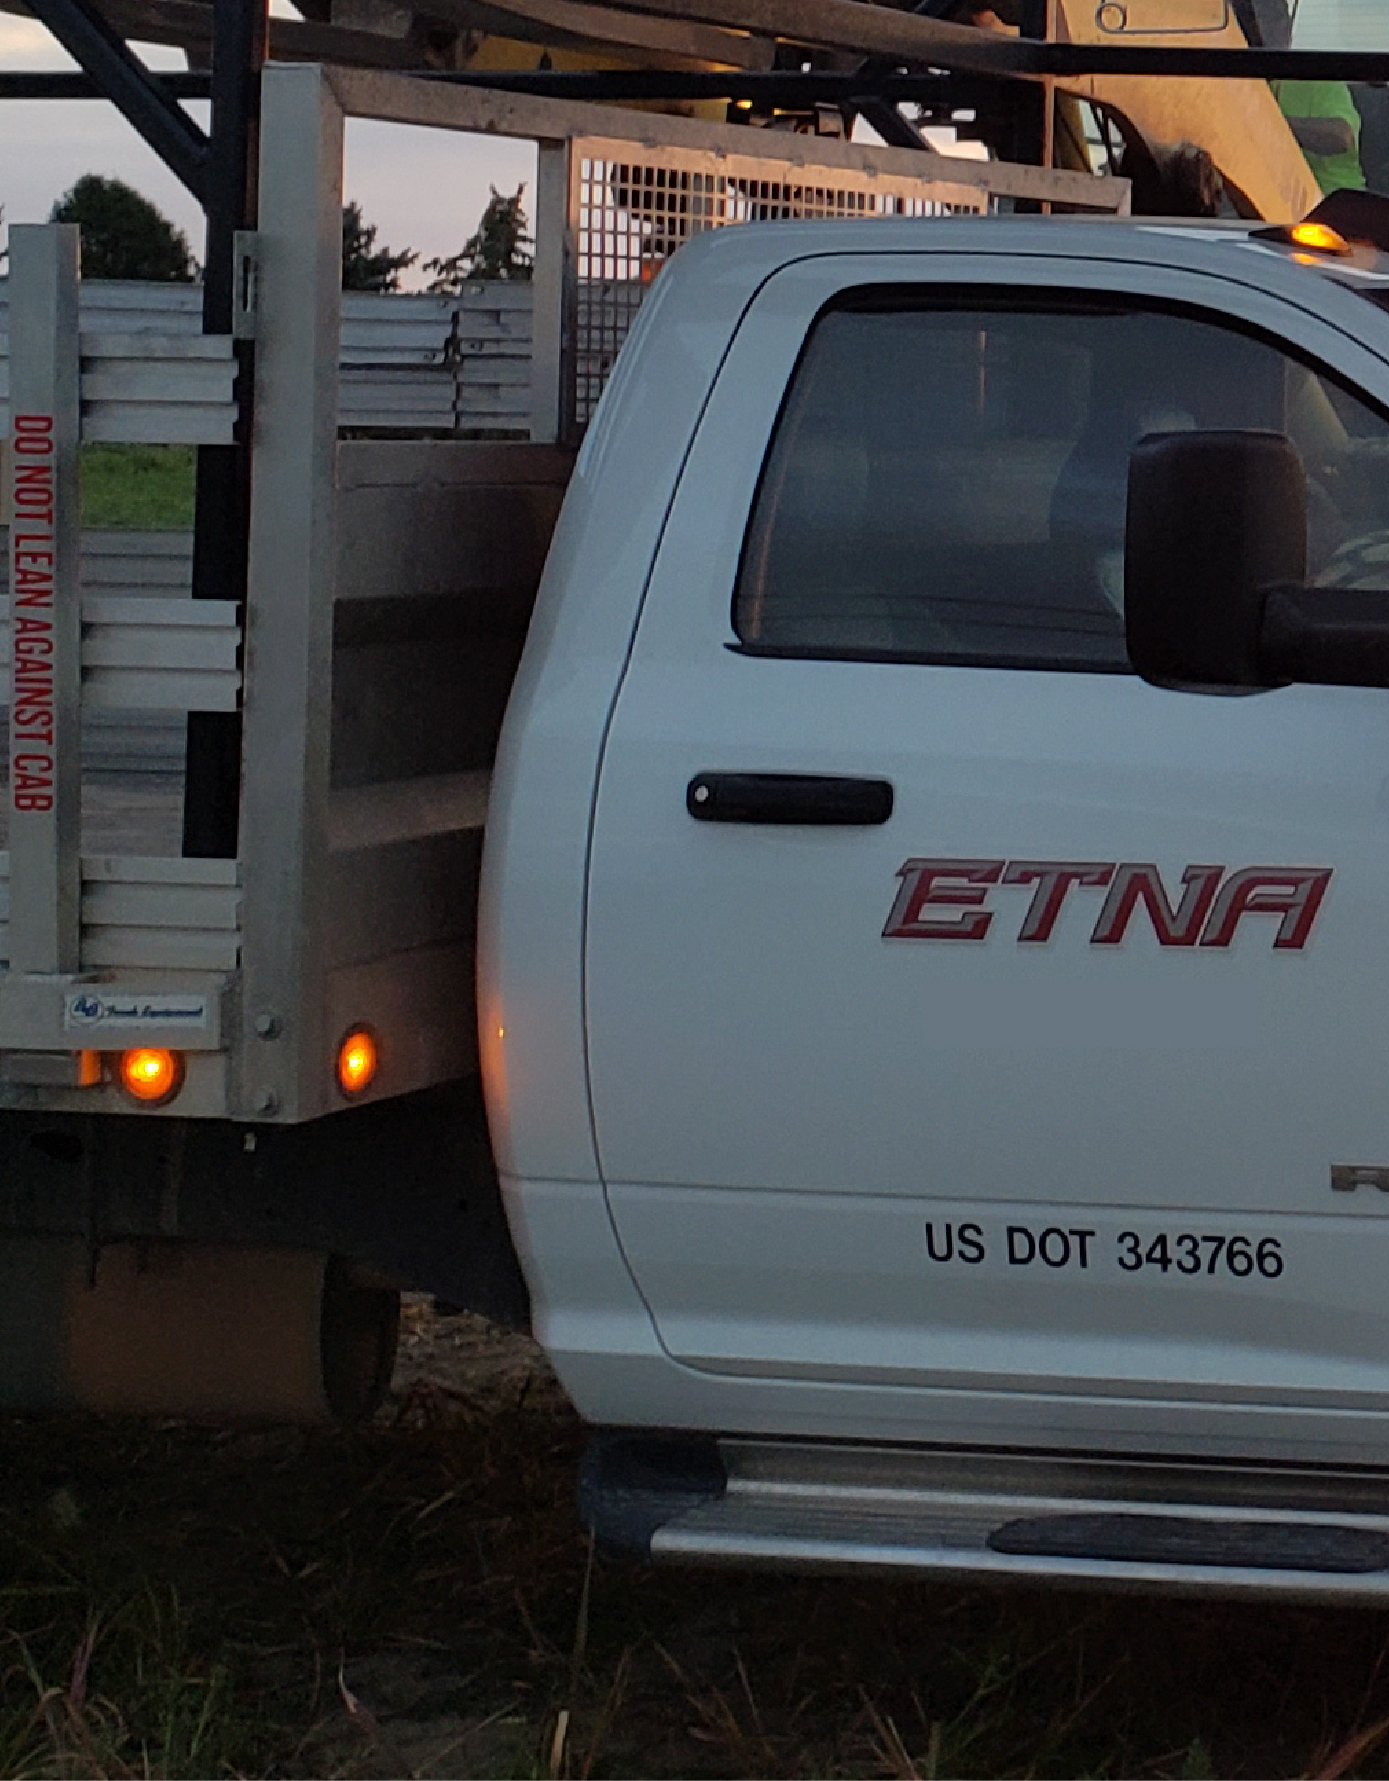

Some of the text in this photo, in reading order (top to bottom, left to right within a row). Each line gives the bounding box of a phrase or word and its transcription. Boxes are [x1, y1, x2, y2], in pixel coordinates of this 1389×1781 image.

[13, 414, 54, 812] DO NOT LEAN AGAINST CAB
[881, 858, 1334, 950] ETNA
[925, 1222, 1284, 1278] US DOT 343766
